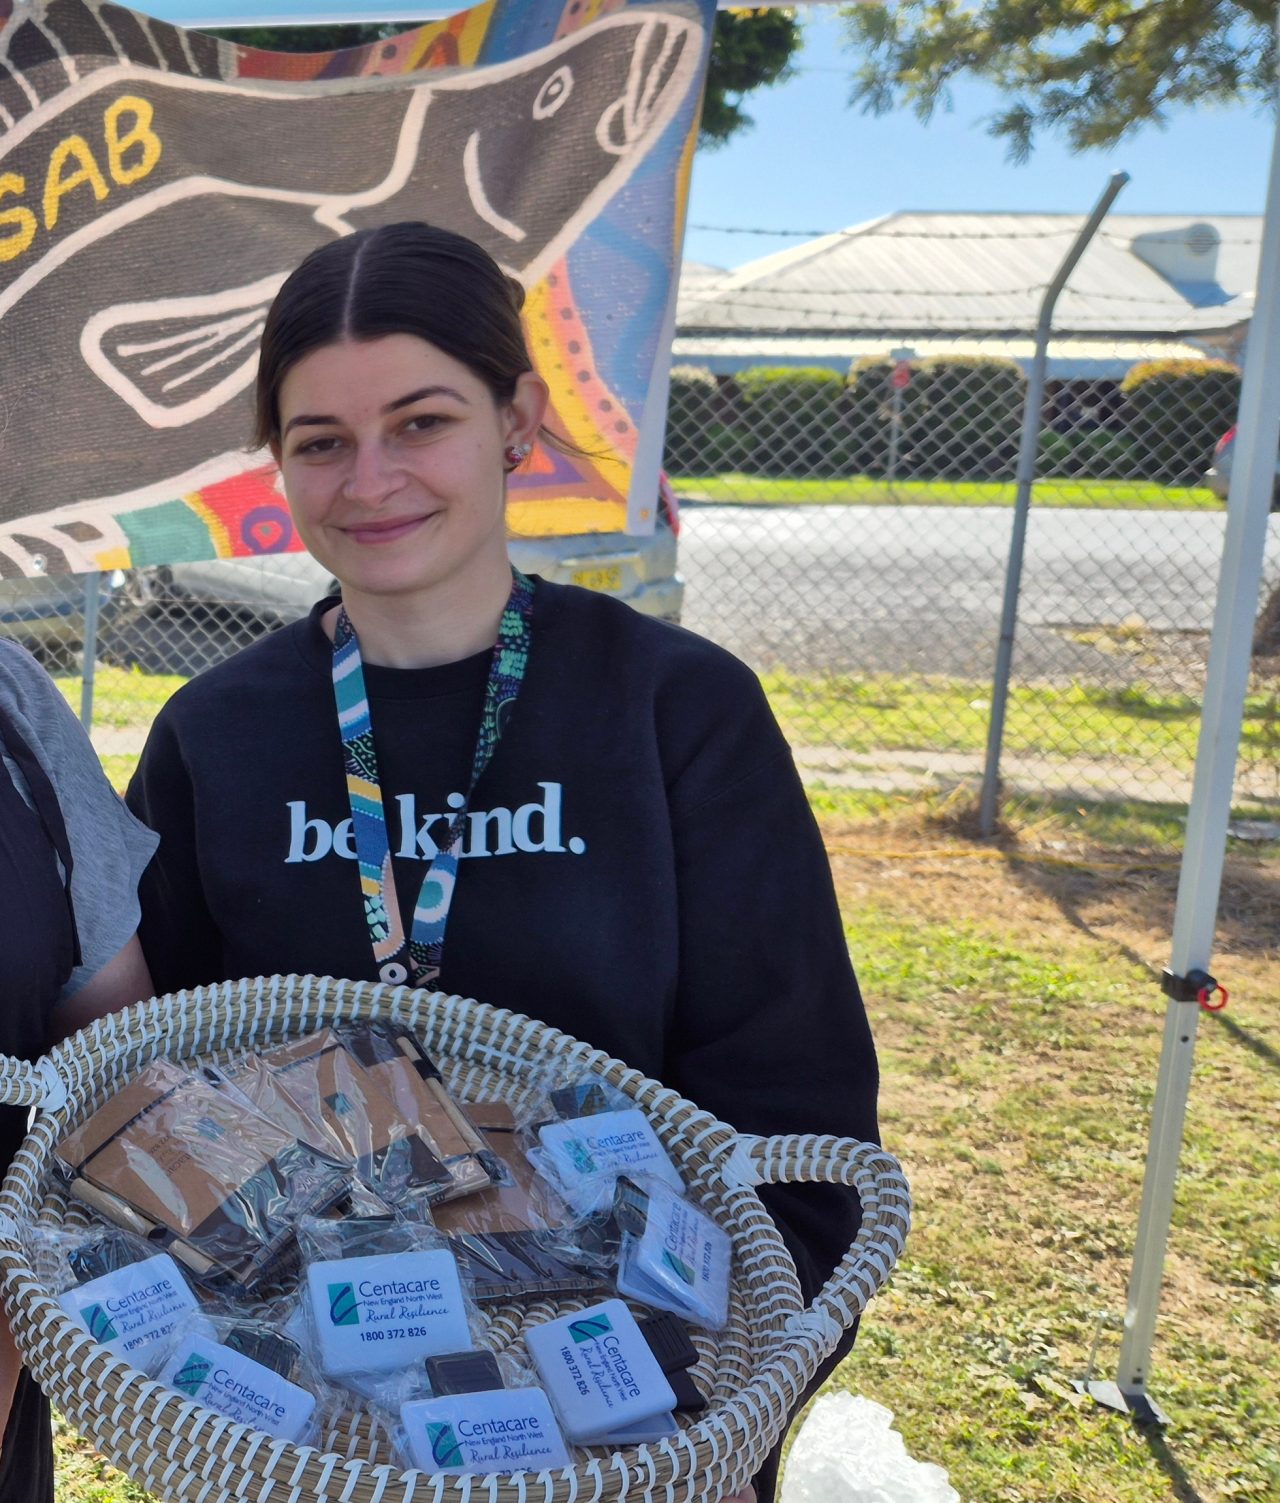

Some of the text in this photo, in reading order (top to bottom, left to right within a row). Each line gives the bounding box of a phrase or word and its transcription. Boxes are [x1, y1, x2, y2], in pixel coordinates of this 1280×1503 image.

[283, 781, 586, 863] be kind.
[586, 1129, 646, 1150] Centacare
[106, 1279, 172, 1312] Centacare
[359, 1279, 440, 1298] Centacare
[380, 1298, 404, 1306] England
[406, 1295, 426, 1303] North
[366, 1304, 449, 1323] Rural Resilience
[360, 1327, 427, 1342] 1800 372 826
[560, 1346, 590, 1396] 1800 372 826
[579, 1346, 613, 1408] Rural Resilience
[603, 1336, 640, 1398] Centacare
[213, 1369, 286, 1418] Centacare
[458, 1417, 539, 1437] Centacare
[481, 1437, 506, 1446] England
[507, 1434, 527, 1442] North
[470, 1443, 552, 1464] Rural Resilience
